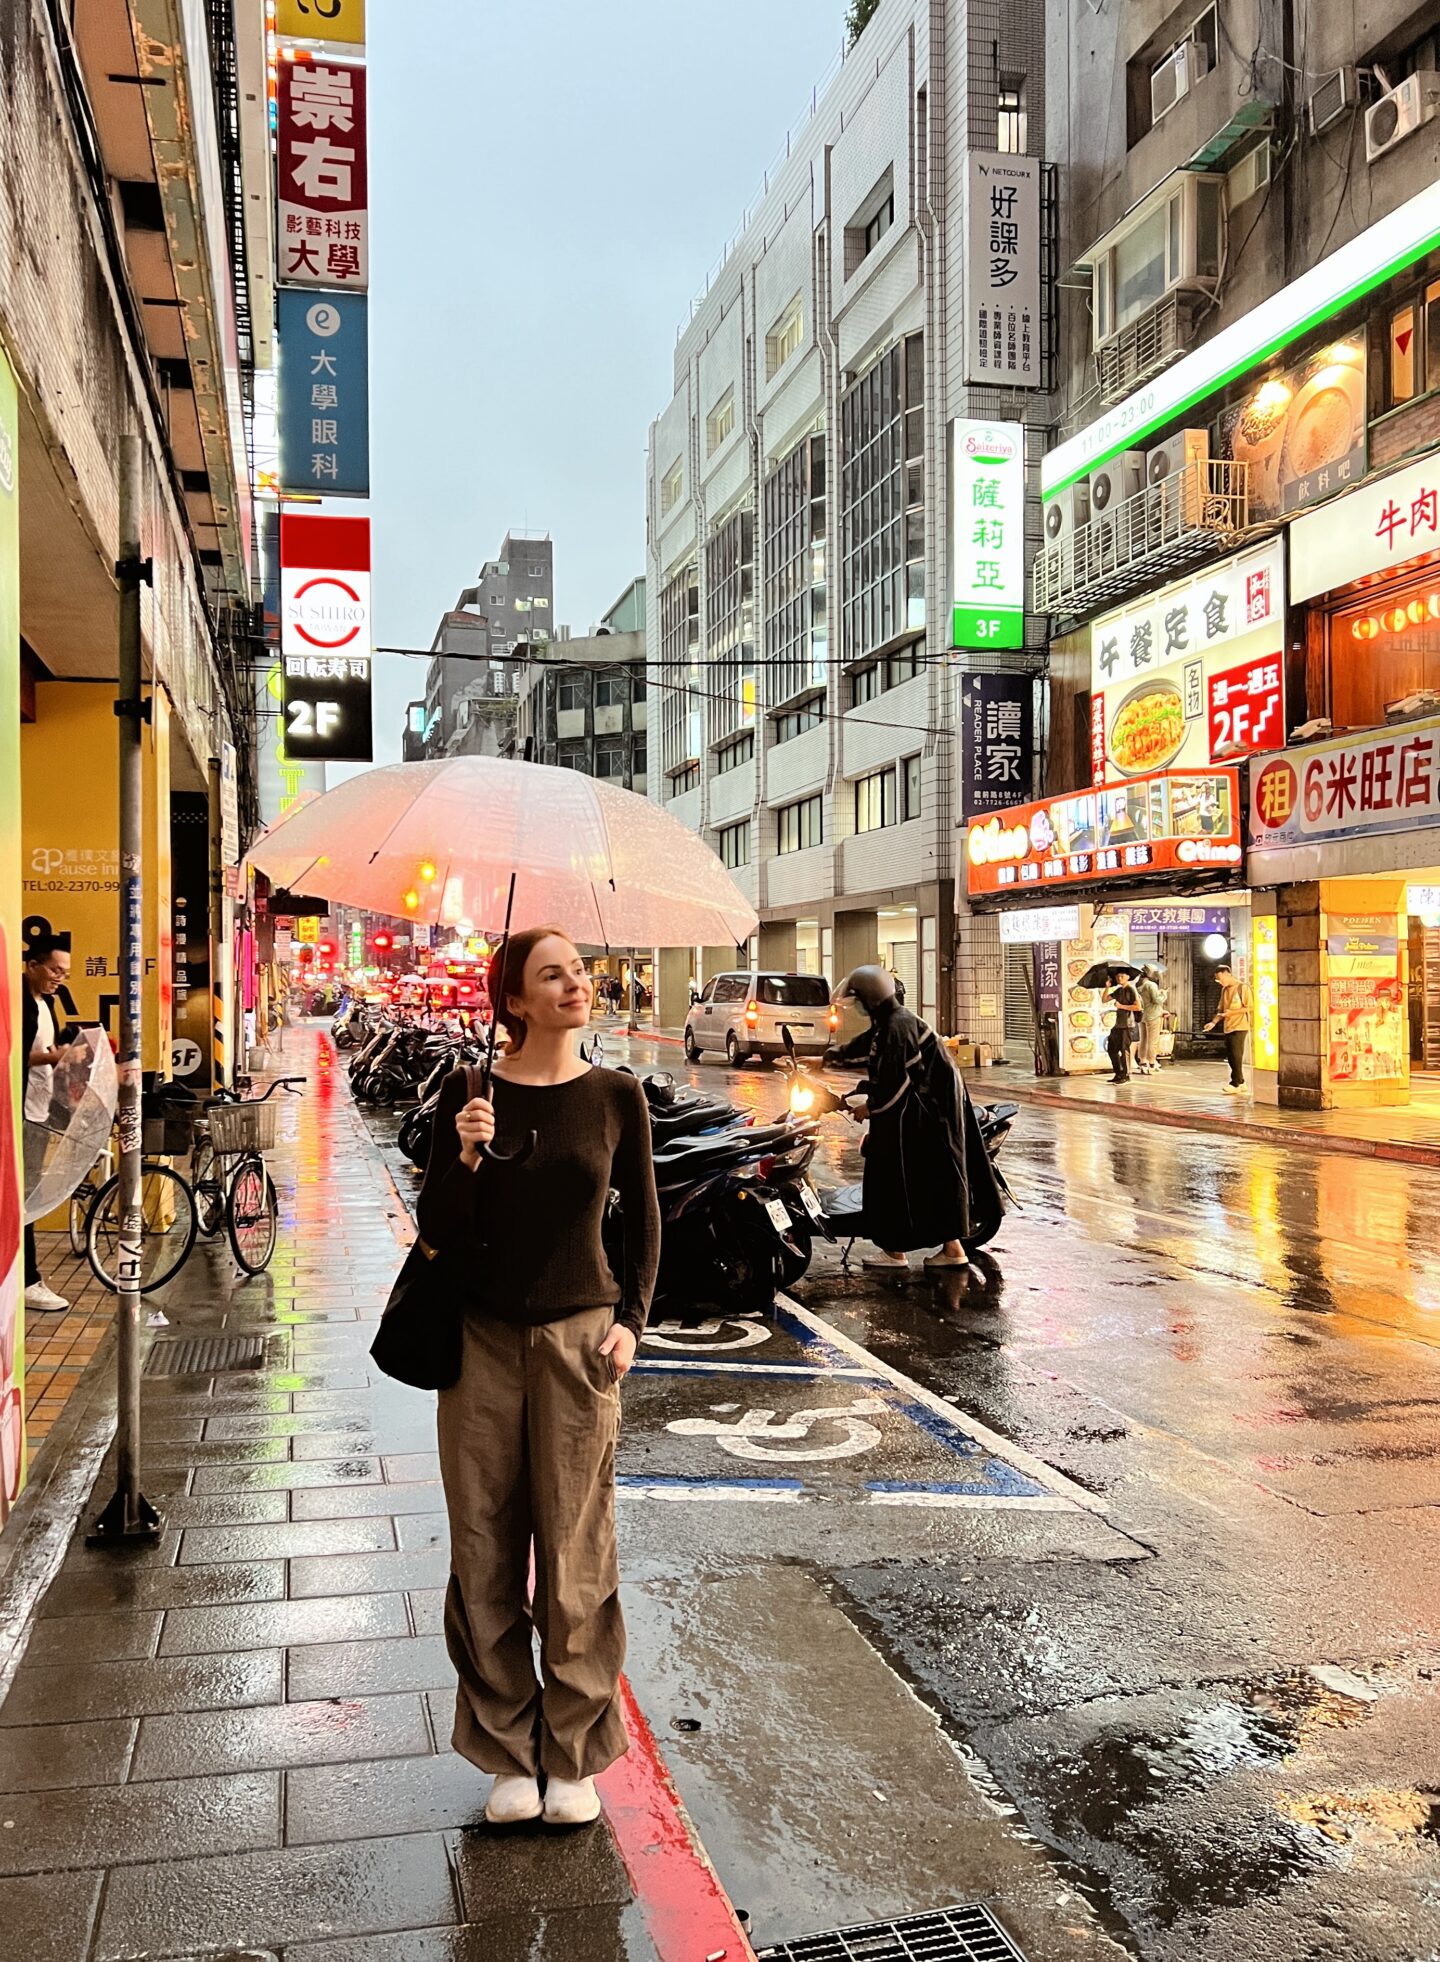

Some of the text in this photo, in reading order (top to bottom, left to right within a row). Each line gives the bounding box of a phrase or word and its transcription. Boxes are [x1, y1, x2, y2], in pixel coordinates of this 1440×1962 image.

[289, 66, 355, 202] 崇右
[286, 214, 361, 241] 影藝科技
[990, 185, 1018, 288] 好課多
[287, 239, 361, 279] 大學
[310, 349, 338, 480] 大學眼科
[966, 437, 1012, 453] Saizeriya
[971, 476, 1006, 591] 薩莉亞
[1375, 487, 1439, 551] 牛肉
[288, 604, 366, 621] SUSHIRO
[308, 622, 347, 634] TAIWAN
[976, 619, 1001, 638] 3F
[1099, 589, 1229, 678] 午餐定食
[286, 656, 368, 680] 回転寿司
[1187, 668, 1201, 712] 名物
[287, 699, 340, 738] 2F
[974, 699, 982, 781] READER PLACE
[986, 700, 1022, 782] 讀家
[1213, 703, 1250, 755] 2F
[1261, 768, 1291, 820] 租
[172, 1048, 198, 1067] 6F
